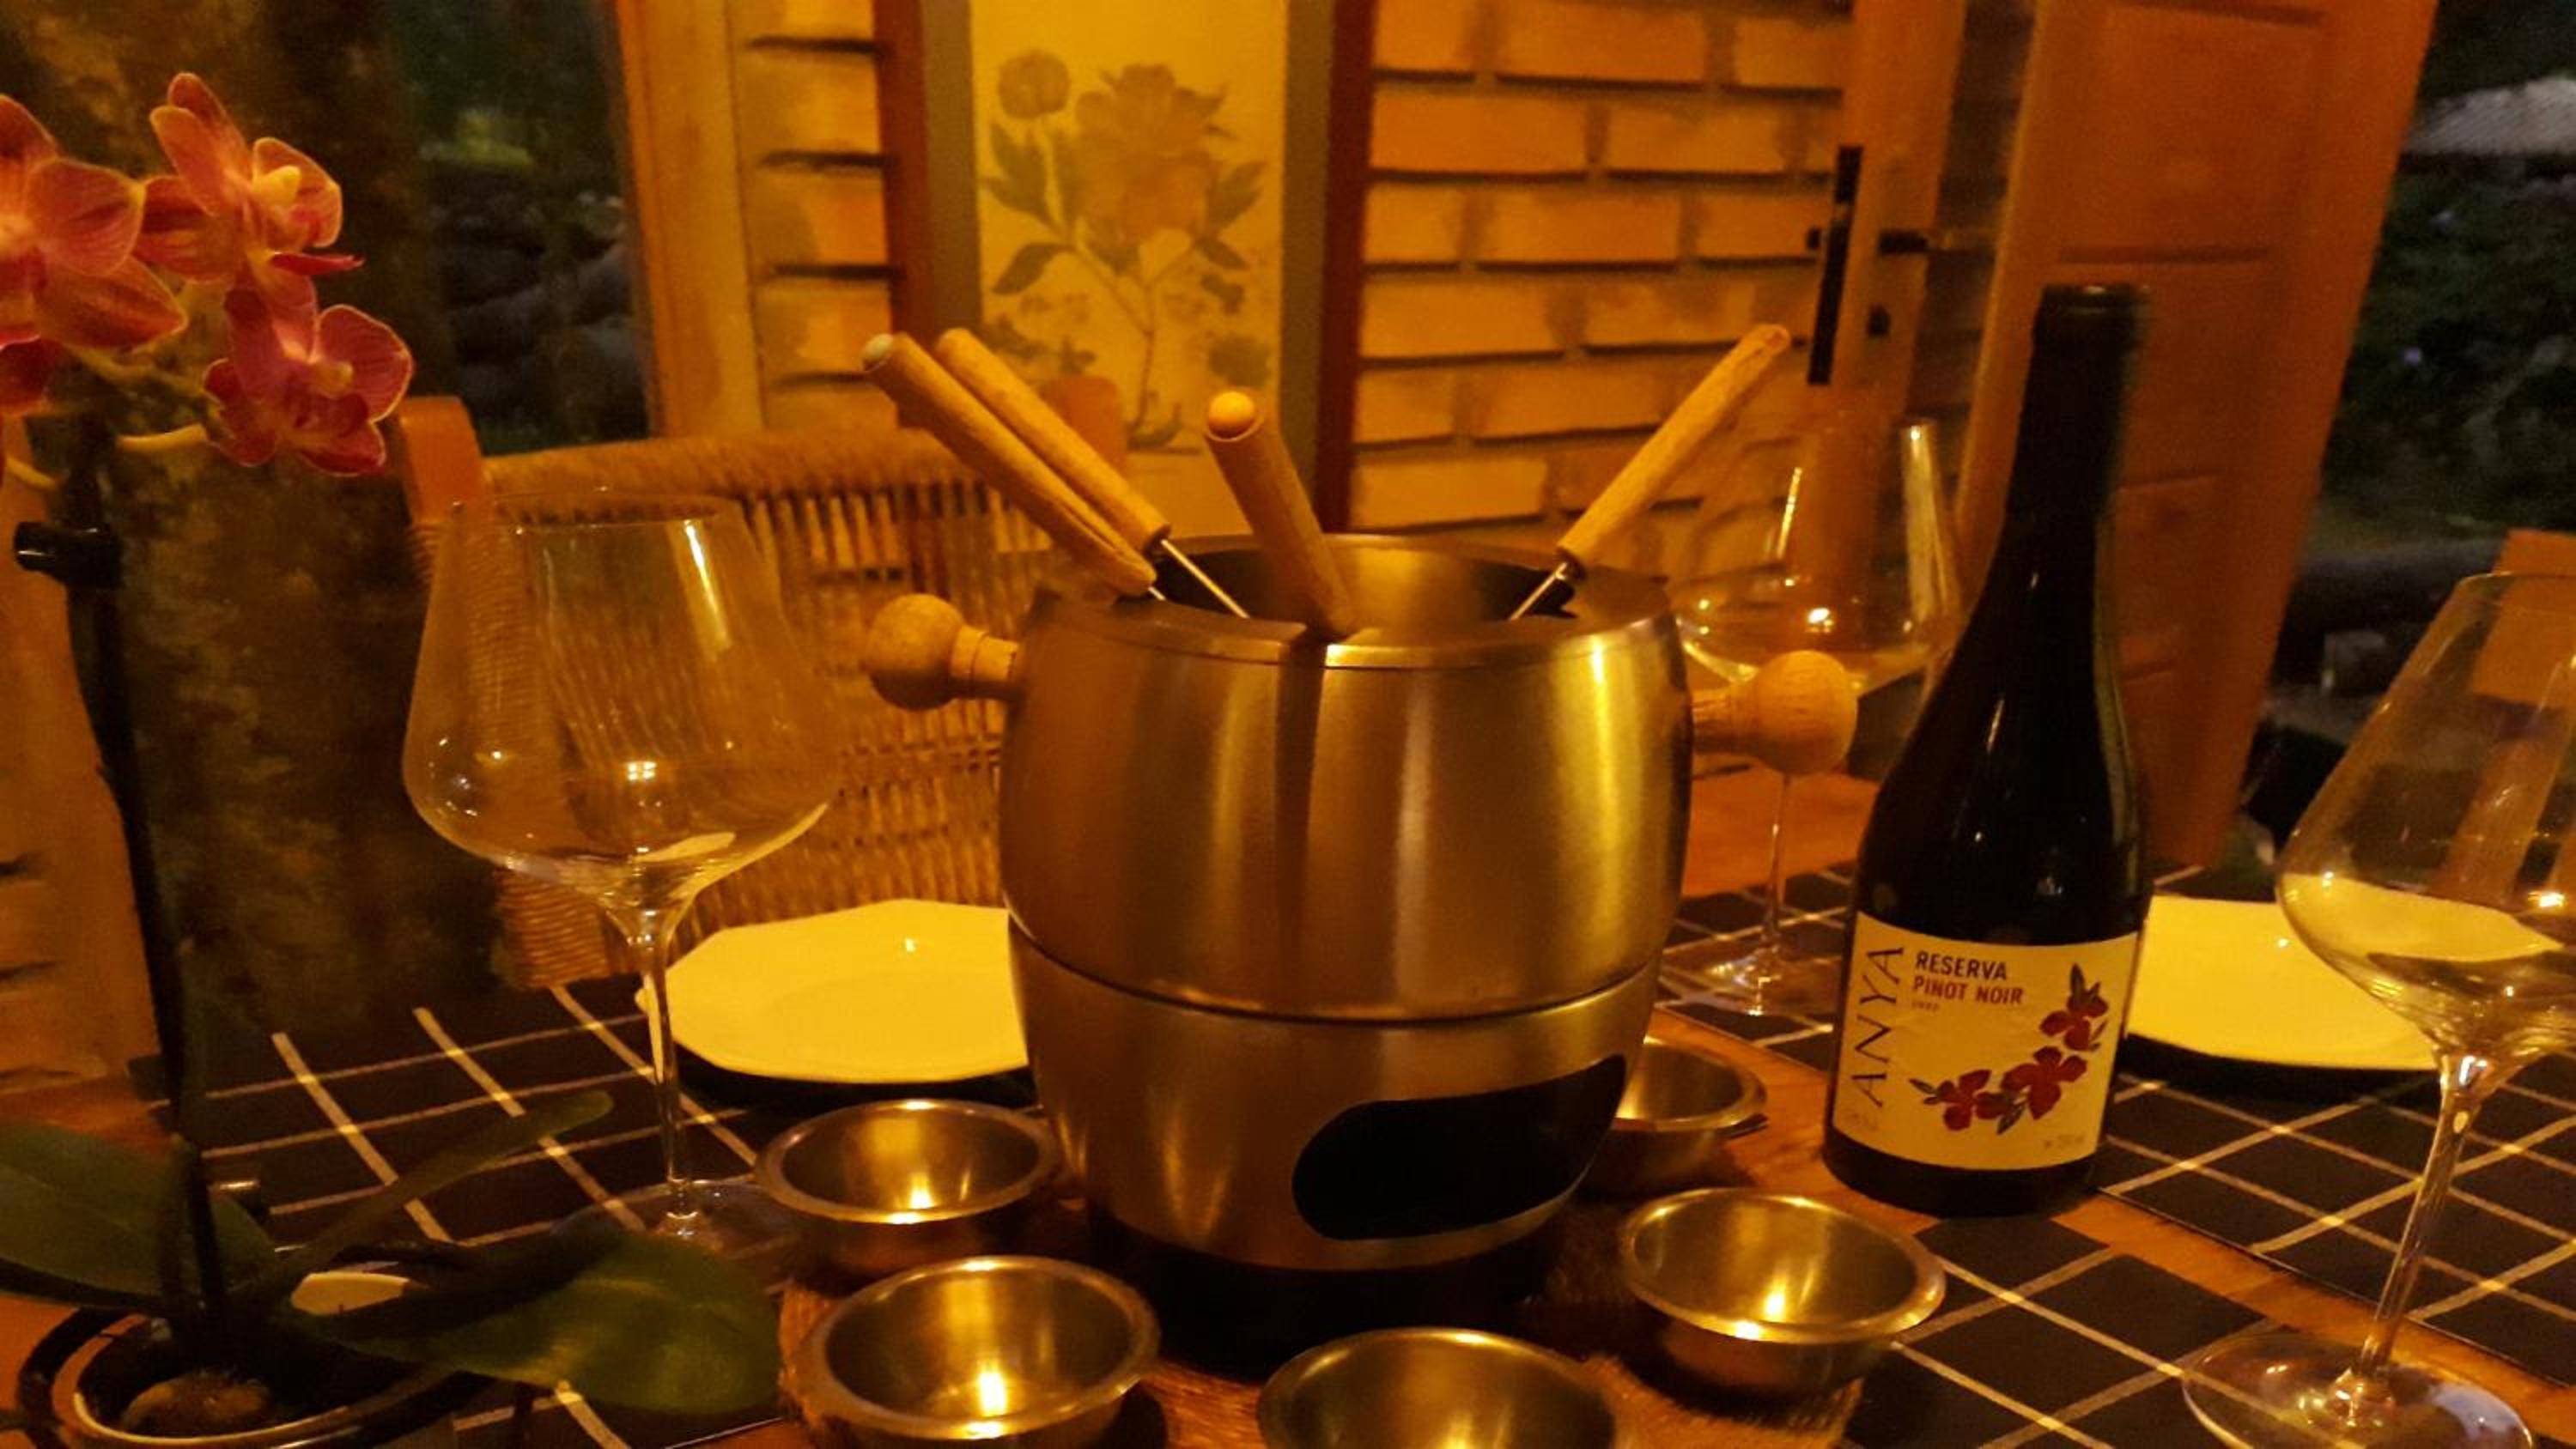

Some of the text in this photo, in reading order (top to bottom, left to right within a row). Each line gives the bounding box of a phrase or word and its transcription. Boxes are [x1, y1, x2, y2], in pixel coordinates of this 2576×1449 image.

[1915, 949, 2008, 981] RESERVA
[1911, 975, 2024, 1006] PINOT NOIR
[1850, 946, 1905, 1109] ANYA
